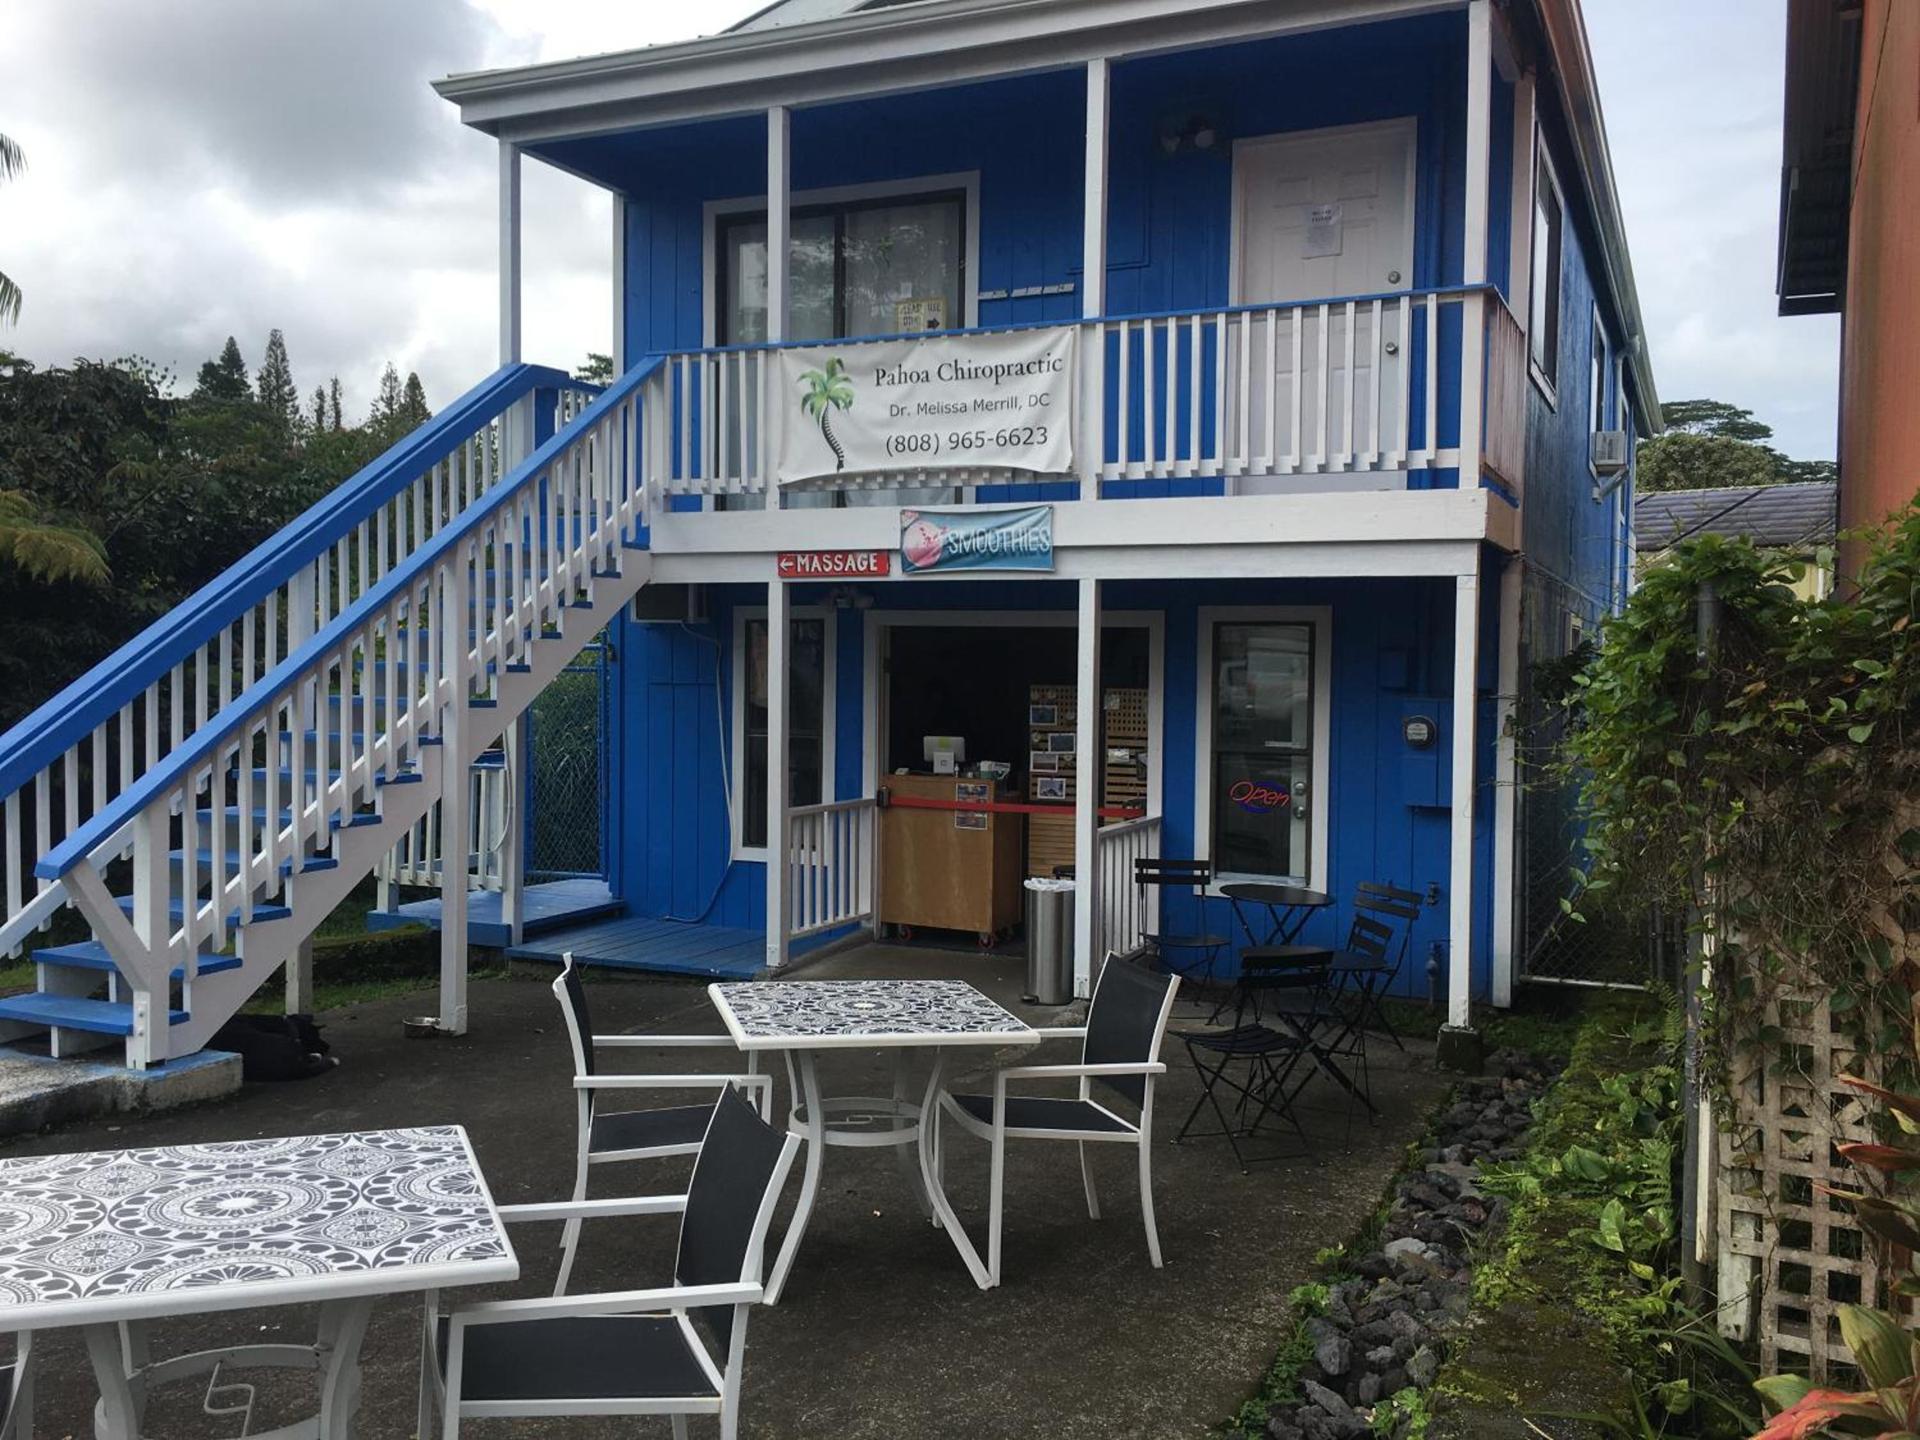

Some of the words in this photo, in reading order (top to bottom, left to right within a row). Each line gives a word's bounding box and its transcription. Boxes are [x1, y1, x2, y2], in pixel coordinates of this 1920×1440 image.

[874, 363, 930, 387] Pahoa
[937, 353, 1064, 385] Chiropractic
[889, 403, 911, 417] Dr.
[917, 400, 967, 416] Melissa
[973, 397, 1022, 413] Merrill,
[1028, 392, 1050, 407] DC
[886, 432, 940, 457] (808)
[949, 426, 1048, 450] 965-6623
[948, 527, 1051, 554] SMOOTHIES
[796, 552, 878, 573] MASSAGE
[1229, 780, 1290, 808] Open
